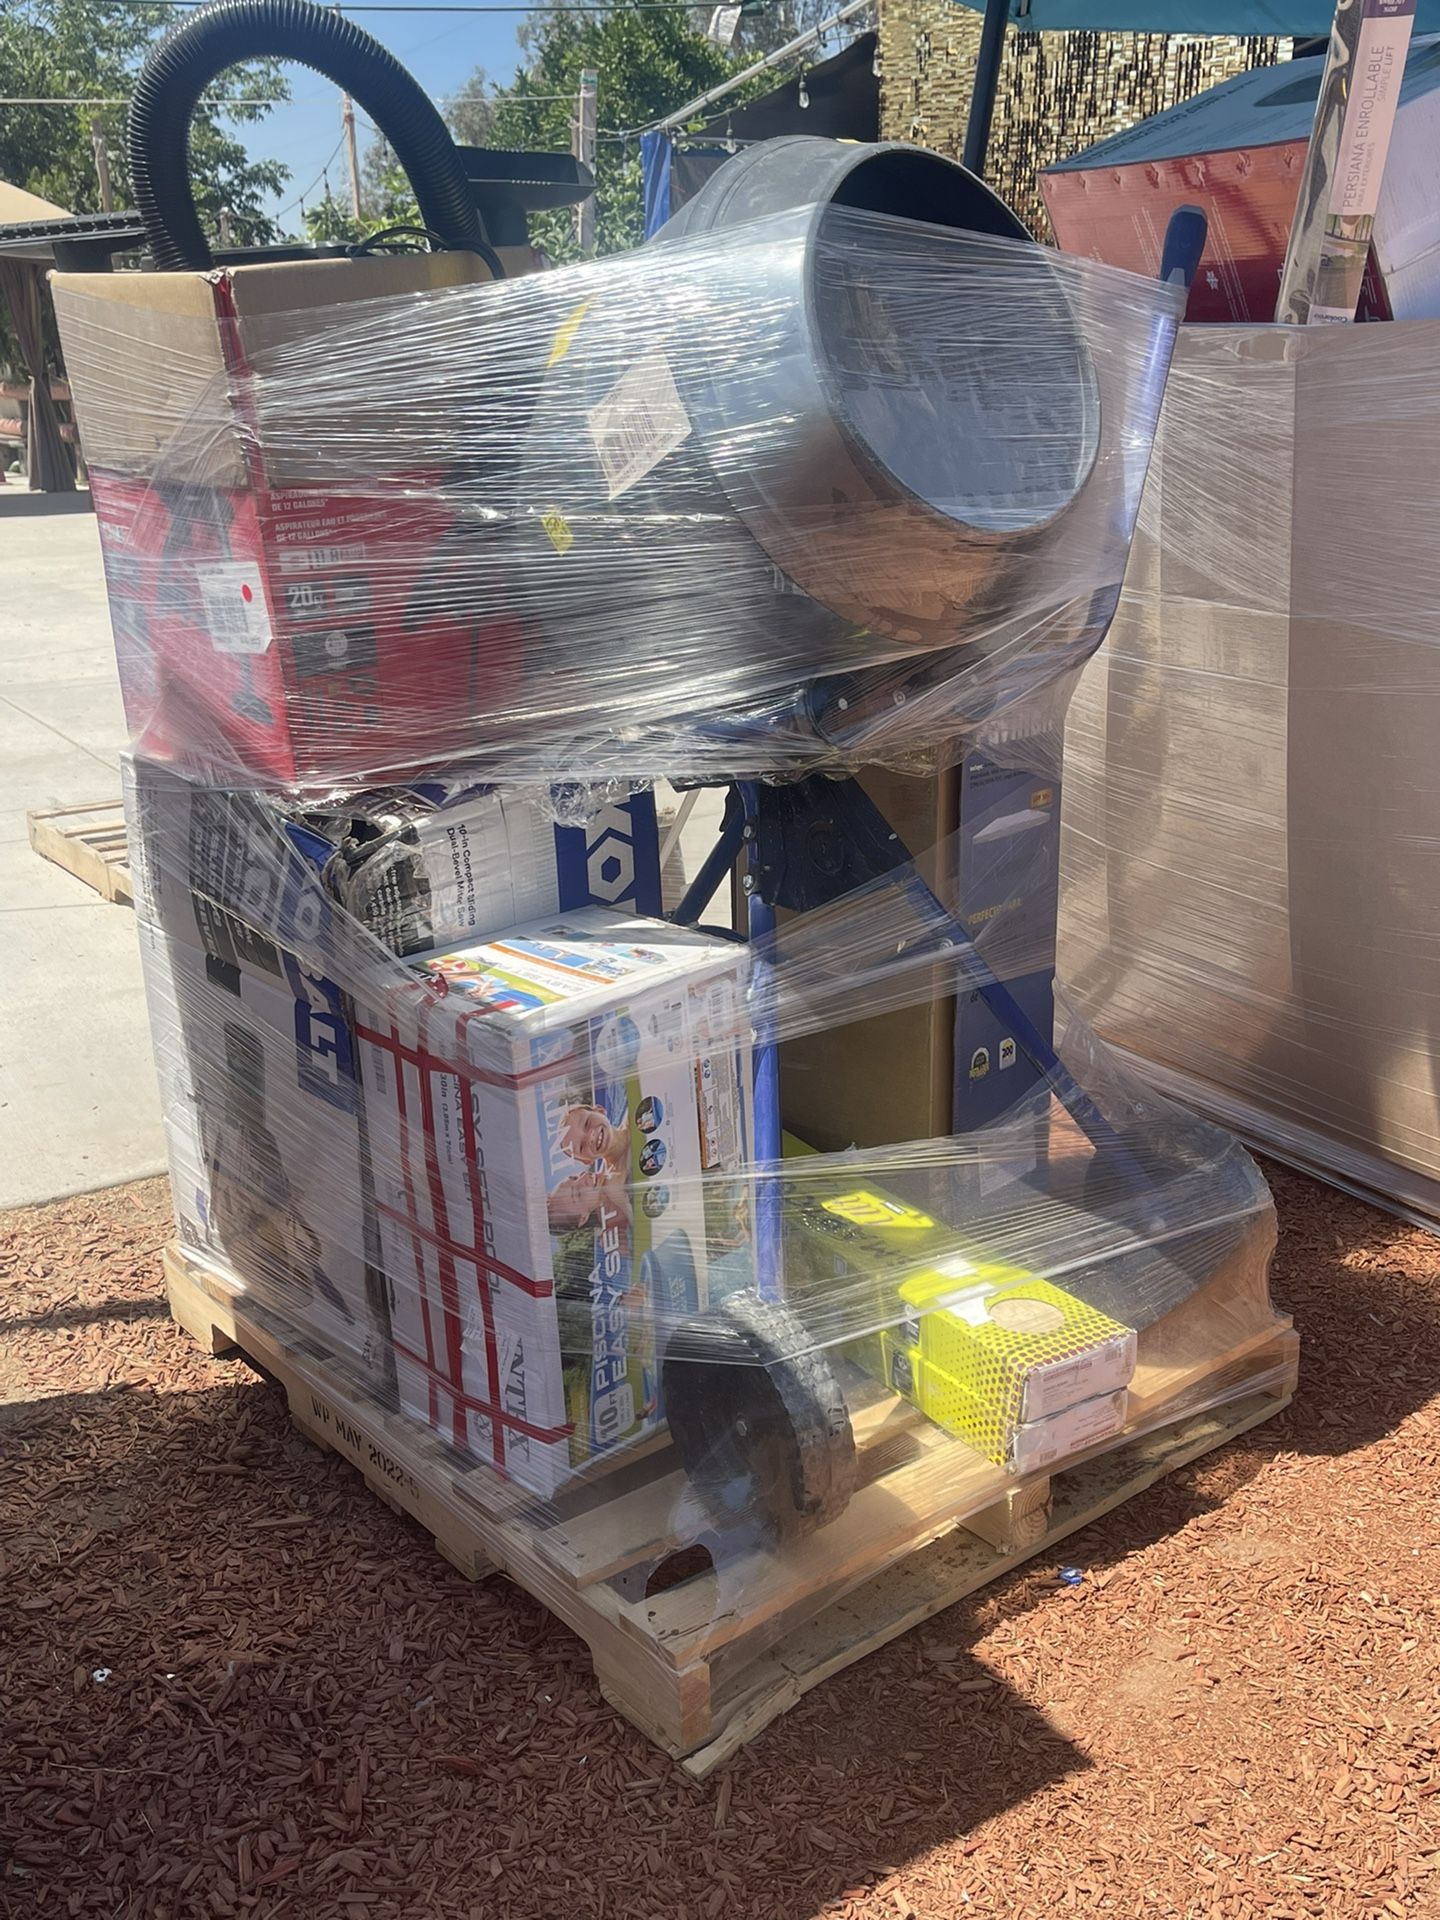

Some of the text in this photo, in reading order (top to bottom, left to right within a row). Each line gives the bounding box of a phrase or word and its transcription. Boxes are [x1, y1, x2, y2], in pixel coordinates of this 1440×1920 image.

[1385, 46, 1395, 66] LIFT
[1342, 46, 1385, 207] PERSIANA ENROLLABLE
[272, 502, 282, 512] DE
[283, 501, 292, 511] 12
[275, 519, 320, 532] ASPIRATEUR
[287, 584, 313, 609] 20
[446, 827, 463, 880] Dual-Bevel
[457, 906, 466, 927] Saw
[457, 823, 477, 927] 10-in Compact Sliding
[601, 1206, 621, 1279] SET
[588, 1262, 611, 1392] PISCINA
[608, 1289, 628, 1383] EASY
[335, 1416, 362, 1452] MAY
[600, 1408, 620, 1440] 10
